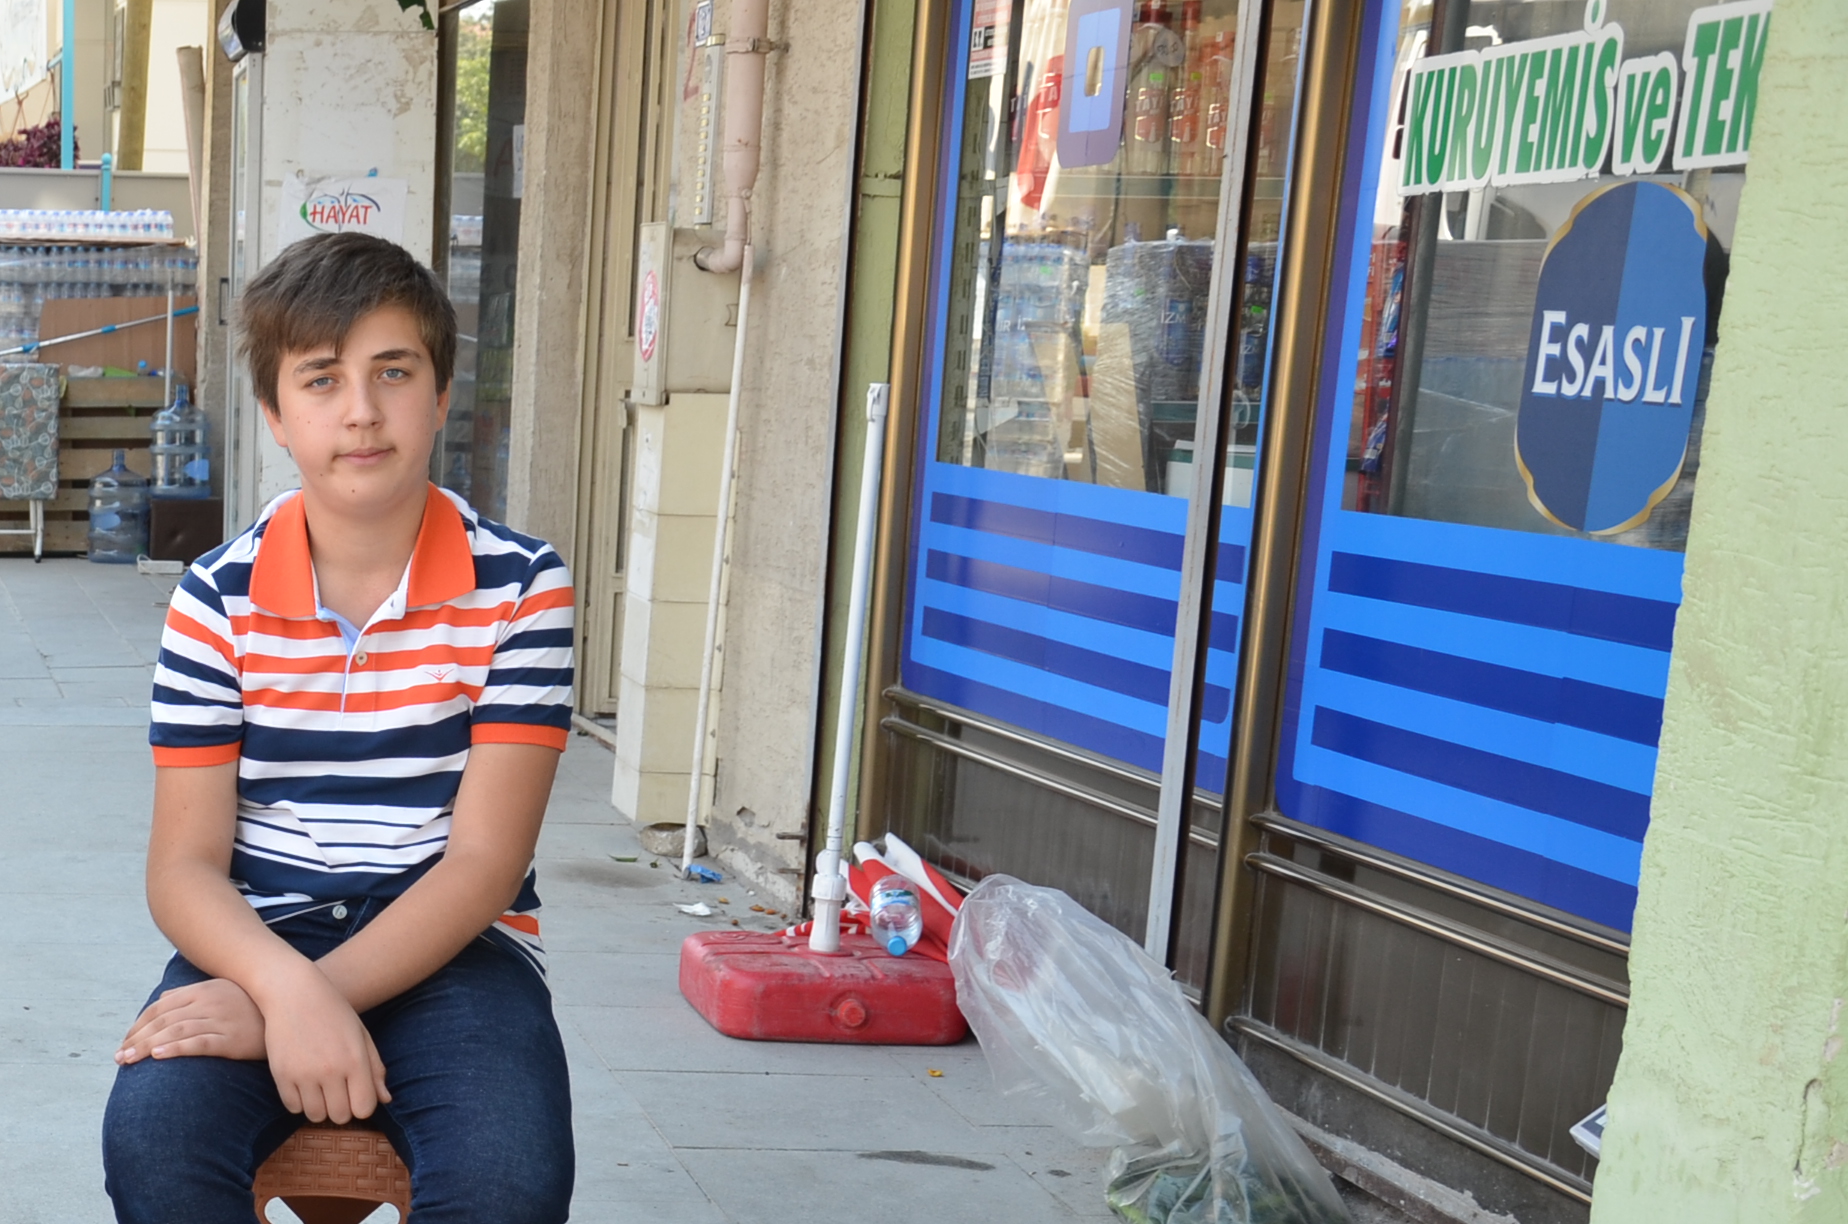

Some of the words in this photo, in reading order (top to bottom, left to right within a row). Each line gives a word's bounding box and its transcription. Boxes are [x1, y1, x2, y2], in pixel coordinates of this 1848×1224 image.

[1620, 66, 1671, 165] ve
[310, 204, 373, 225] HAYAT
[1531, 310, 1696, 405] ESASLI
